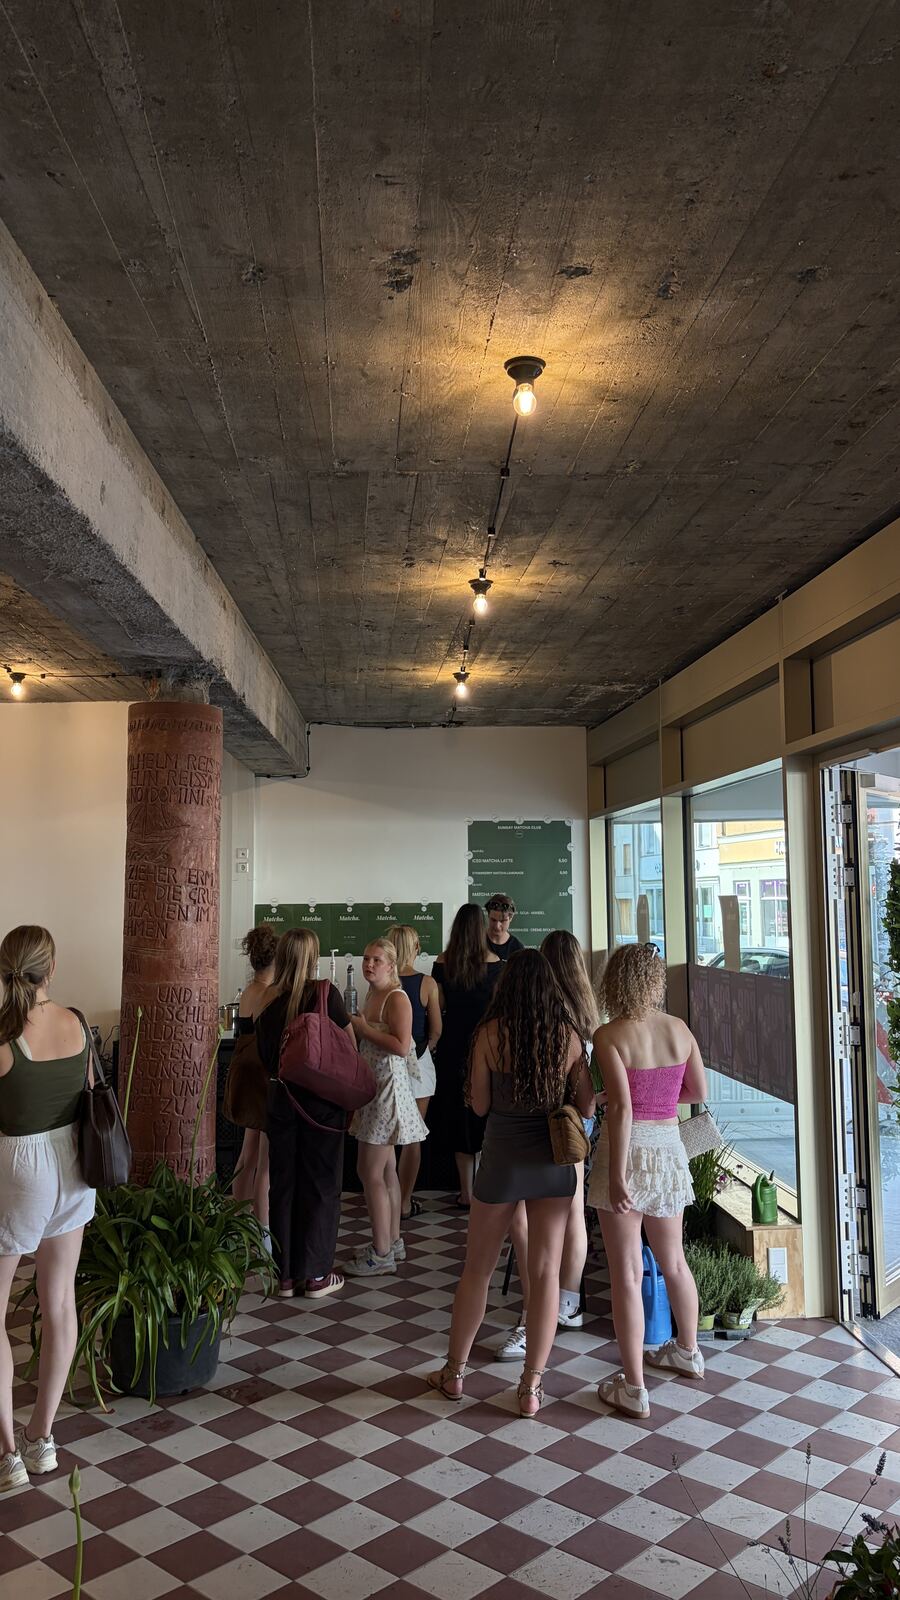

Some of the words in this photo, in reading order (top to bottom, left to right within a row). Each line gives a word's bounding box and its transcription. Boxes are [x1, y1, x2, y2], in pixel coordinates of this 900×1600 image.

[154, 884, 183, 903] DIE
[158, 987, 193, 1005] UND
[159, 1097, 188, 1118] ZU
